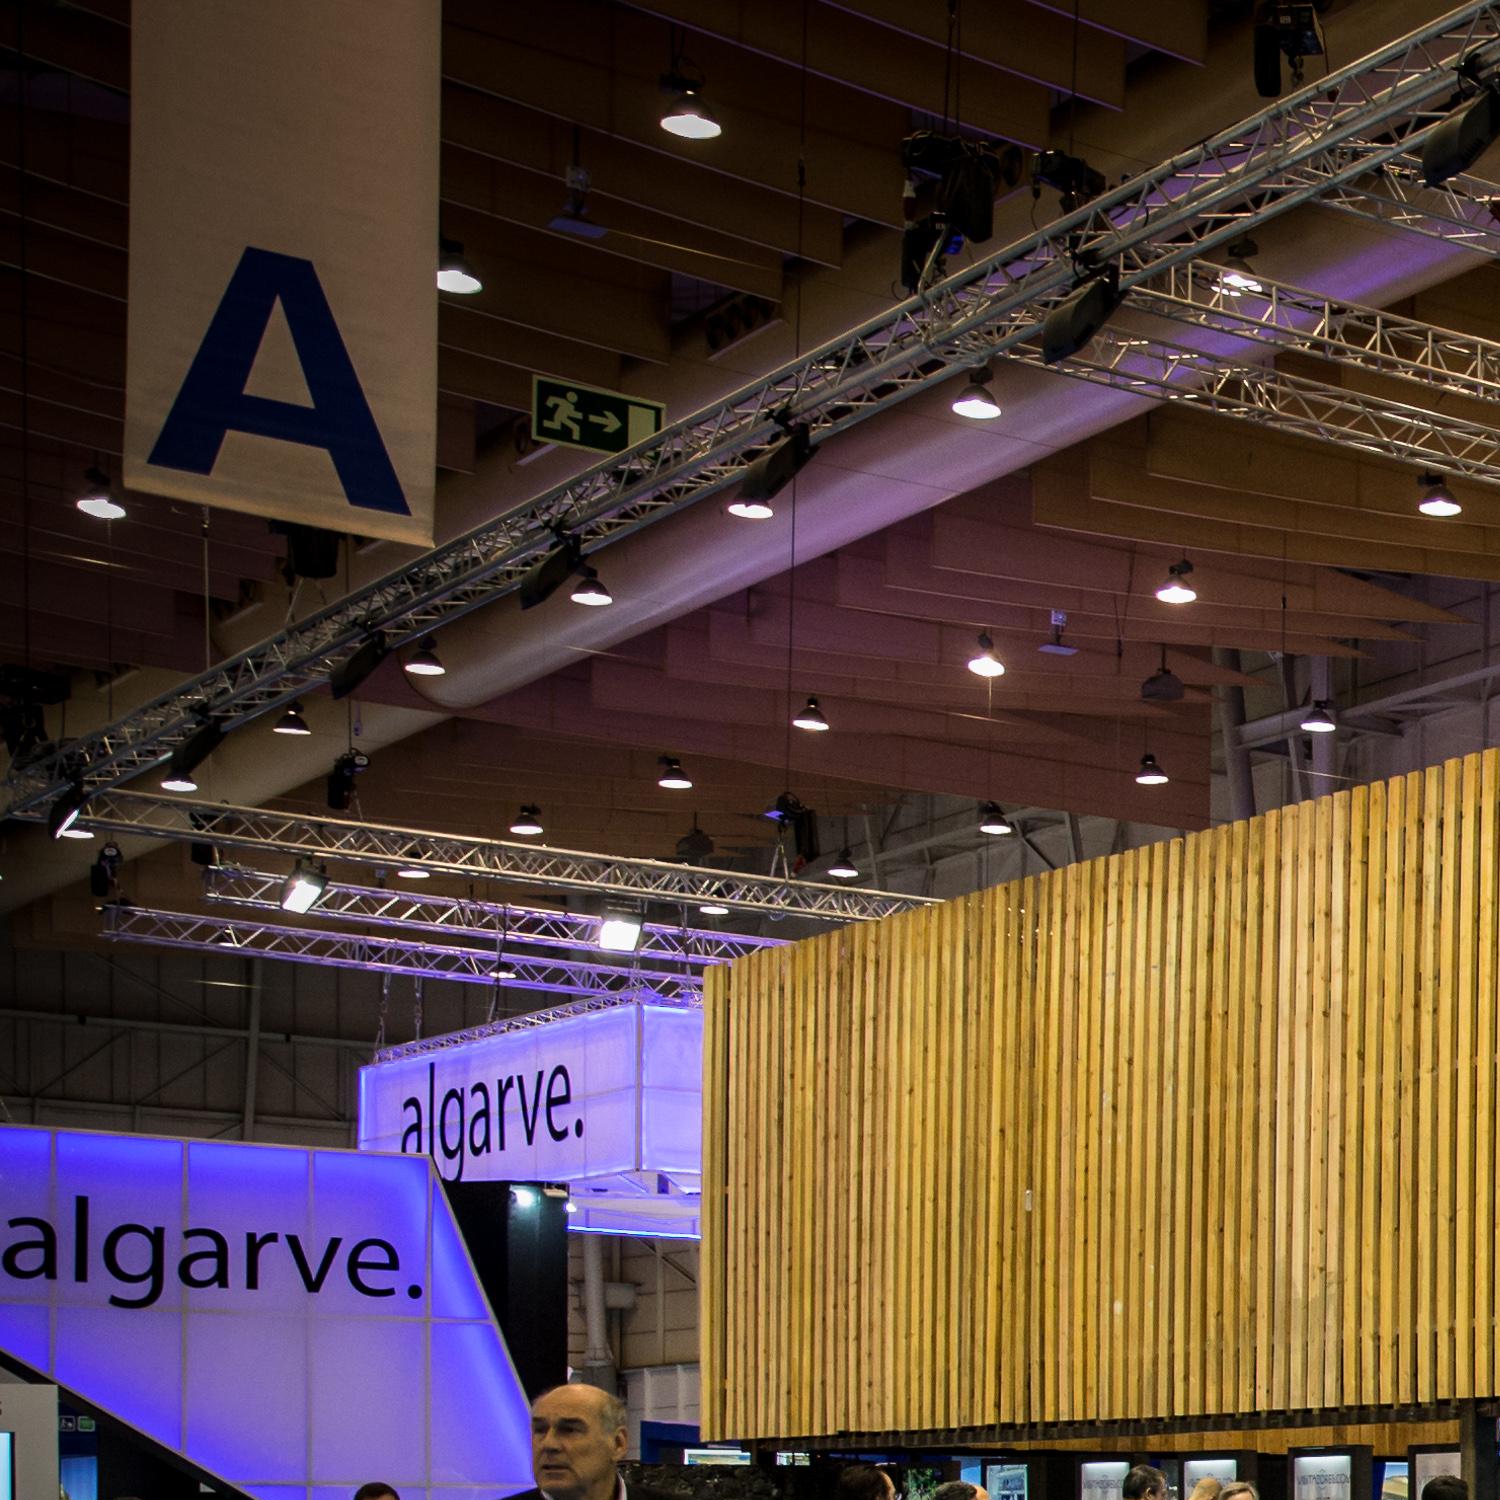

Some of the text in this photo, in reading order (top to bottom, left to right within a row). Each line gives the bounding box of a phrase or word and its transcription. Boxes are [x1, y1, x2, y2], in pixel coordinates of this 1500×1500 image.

[147, 246, 411, 517] A
[401, 1062, 585, 1182] algarve.
[2, 1195, 423, 1310] algarve.
